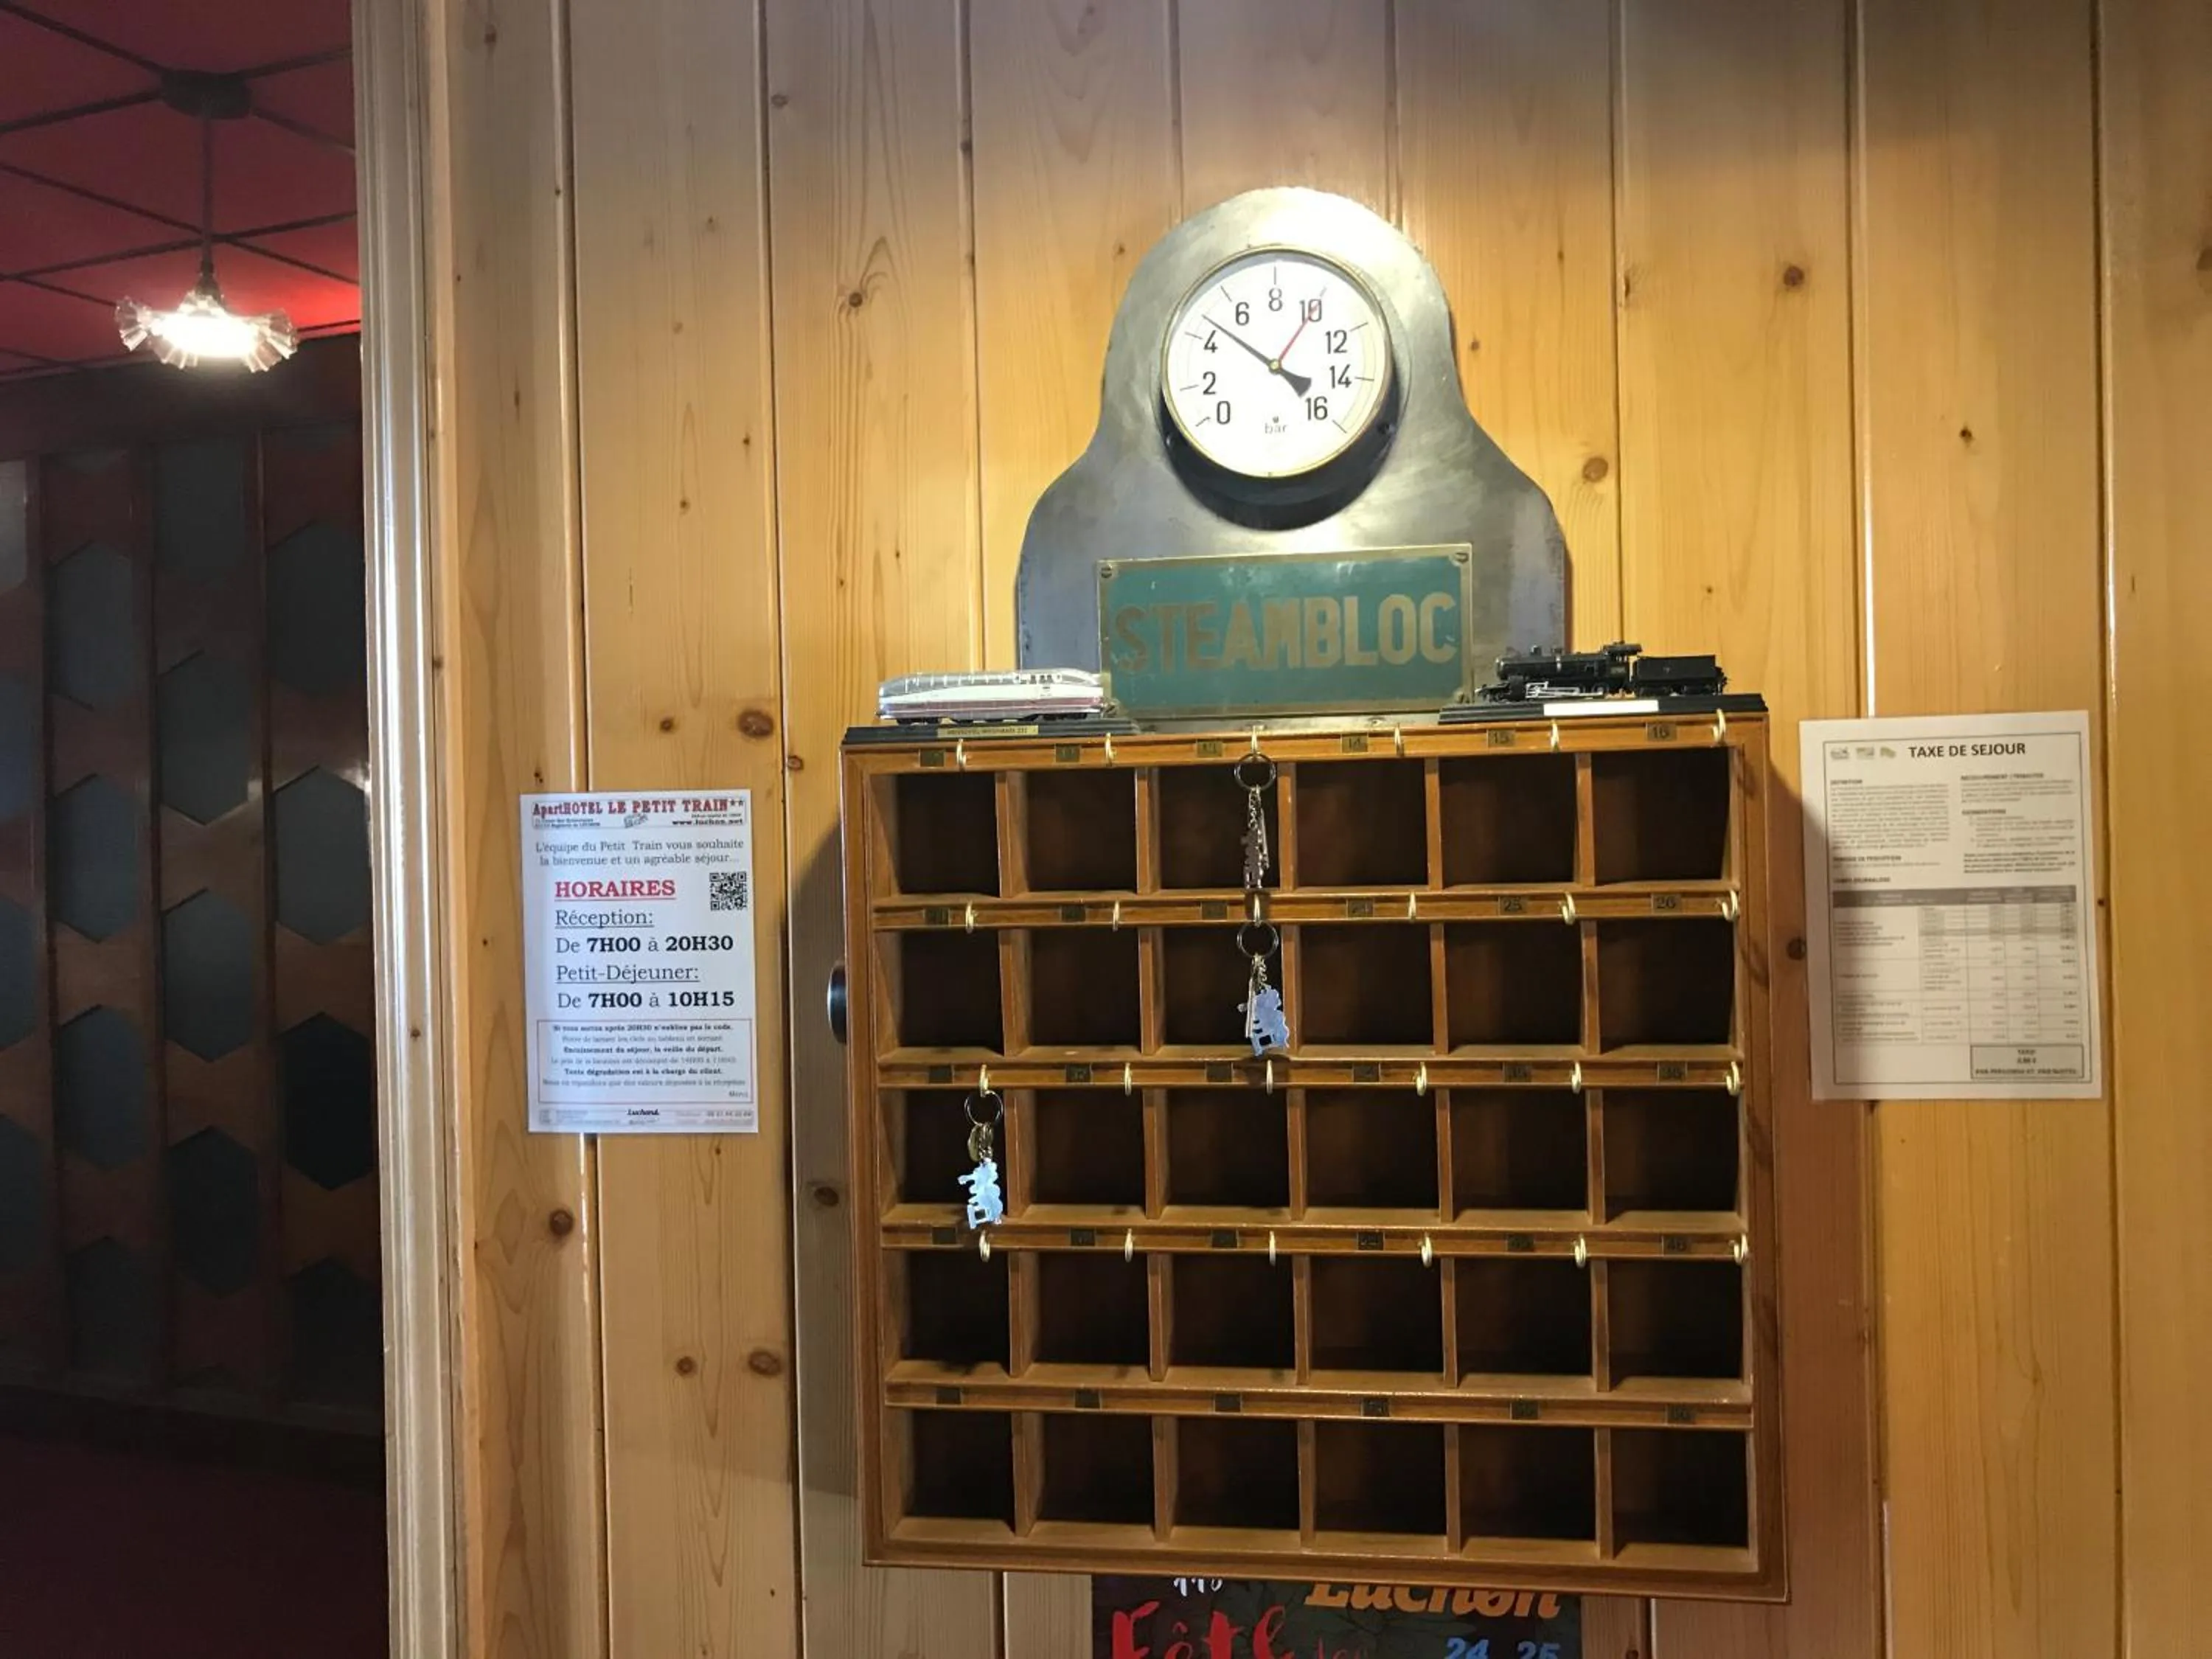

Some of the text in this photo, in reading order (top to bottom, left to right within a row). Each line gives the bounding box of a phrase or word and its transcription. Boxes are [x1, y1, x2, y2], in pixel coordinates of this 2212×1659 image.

[1268, 288, 1283, 312] 8
[1235, 302, 1250, 326] 6
[1298, 299, 1323, 323] 10
[1203, 330, 1219, 353] 4
[1325, 329, 1348, 354] 12
[1203, 372, 1217, 395] 2
[1329, 364, 1352, 389] 14
[1217, 400, 1231, 425] 0
[1305, 396, 1328, 421] 16
[1265, 422, 1288, 434] bar
[1114, 592, 1457, 675] STEAMBLOC
[1908, 742, 2026, 759] TAXE DE SEJOUR
[532, 801, 603, 818] ApartHOTEL
[608, 801, 627, 814] LE
[633, 799, 676, 814] PETIT
[536, 838, 744, 854] L'équipe du Petit Train vous souhaite
[540, 855, 549, 866] la
[552, 855, 608, 866] bienvenue
[611, 855, 622, 865] et
[625, 856, 641, 865] un
[644, 853, 691, 866] agréable
[554, 880, 676, 898] HORAIRES
[555, 908, 653, 928] Réception:
[556, 935, 734, 953] De 7H00 à 20H30
[556, 964, 699, 984] Petit-Déjeuner:
[557, 991, 734, 1009] De 7H00 à 10H15
